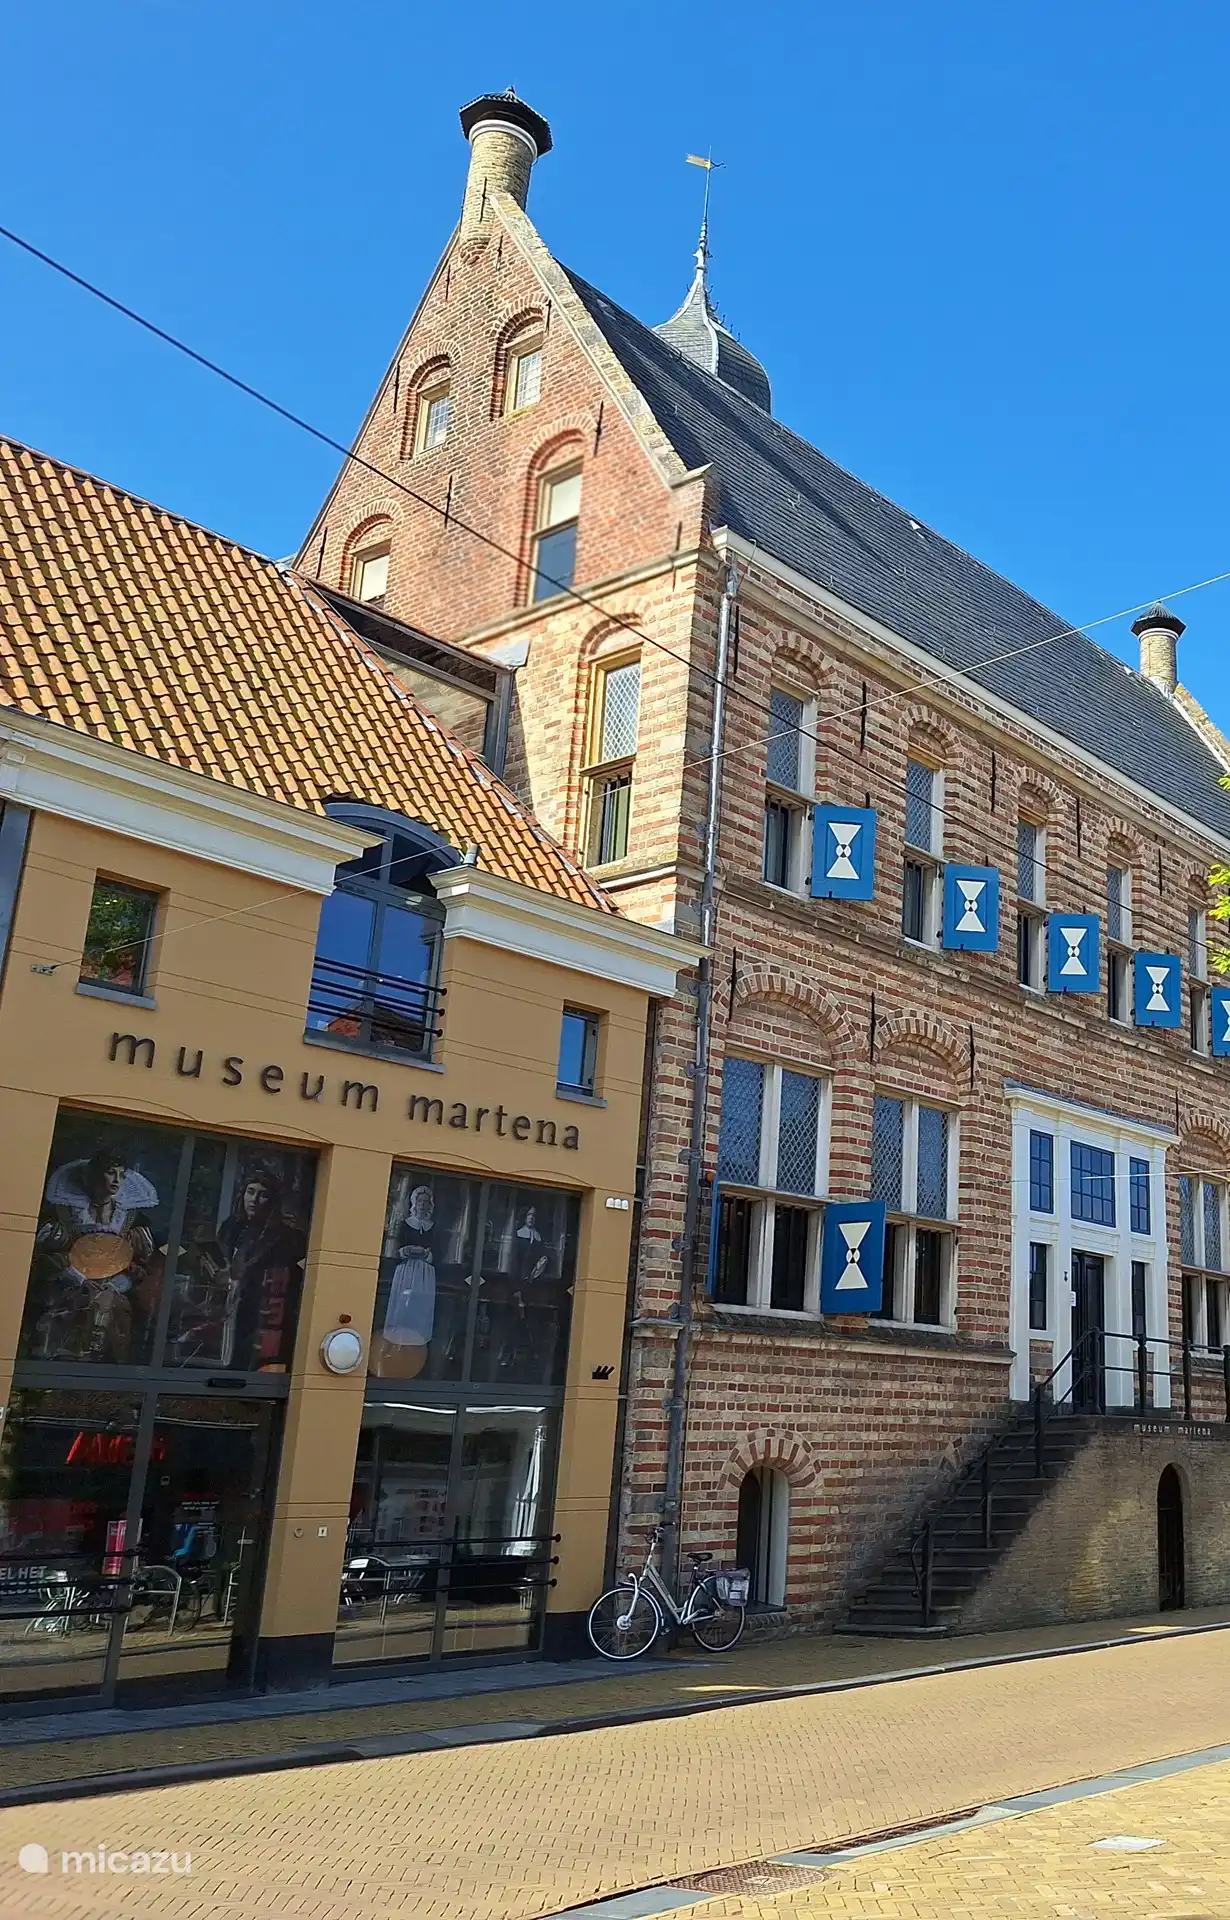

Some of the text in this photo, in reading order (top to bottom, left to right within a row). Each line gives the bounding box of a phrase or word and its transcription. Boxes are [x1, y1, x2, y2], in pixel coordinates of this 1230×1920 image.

[108, 1031, 580, 1151] museum martena
[1133, 1424, 1170, 1433] museum
[18, 1565, 48, 1579] HET
